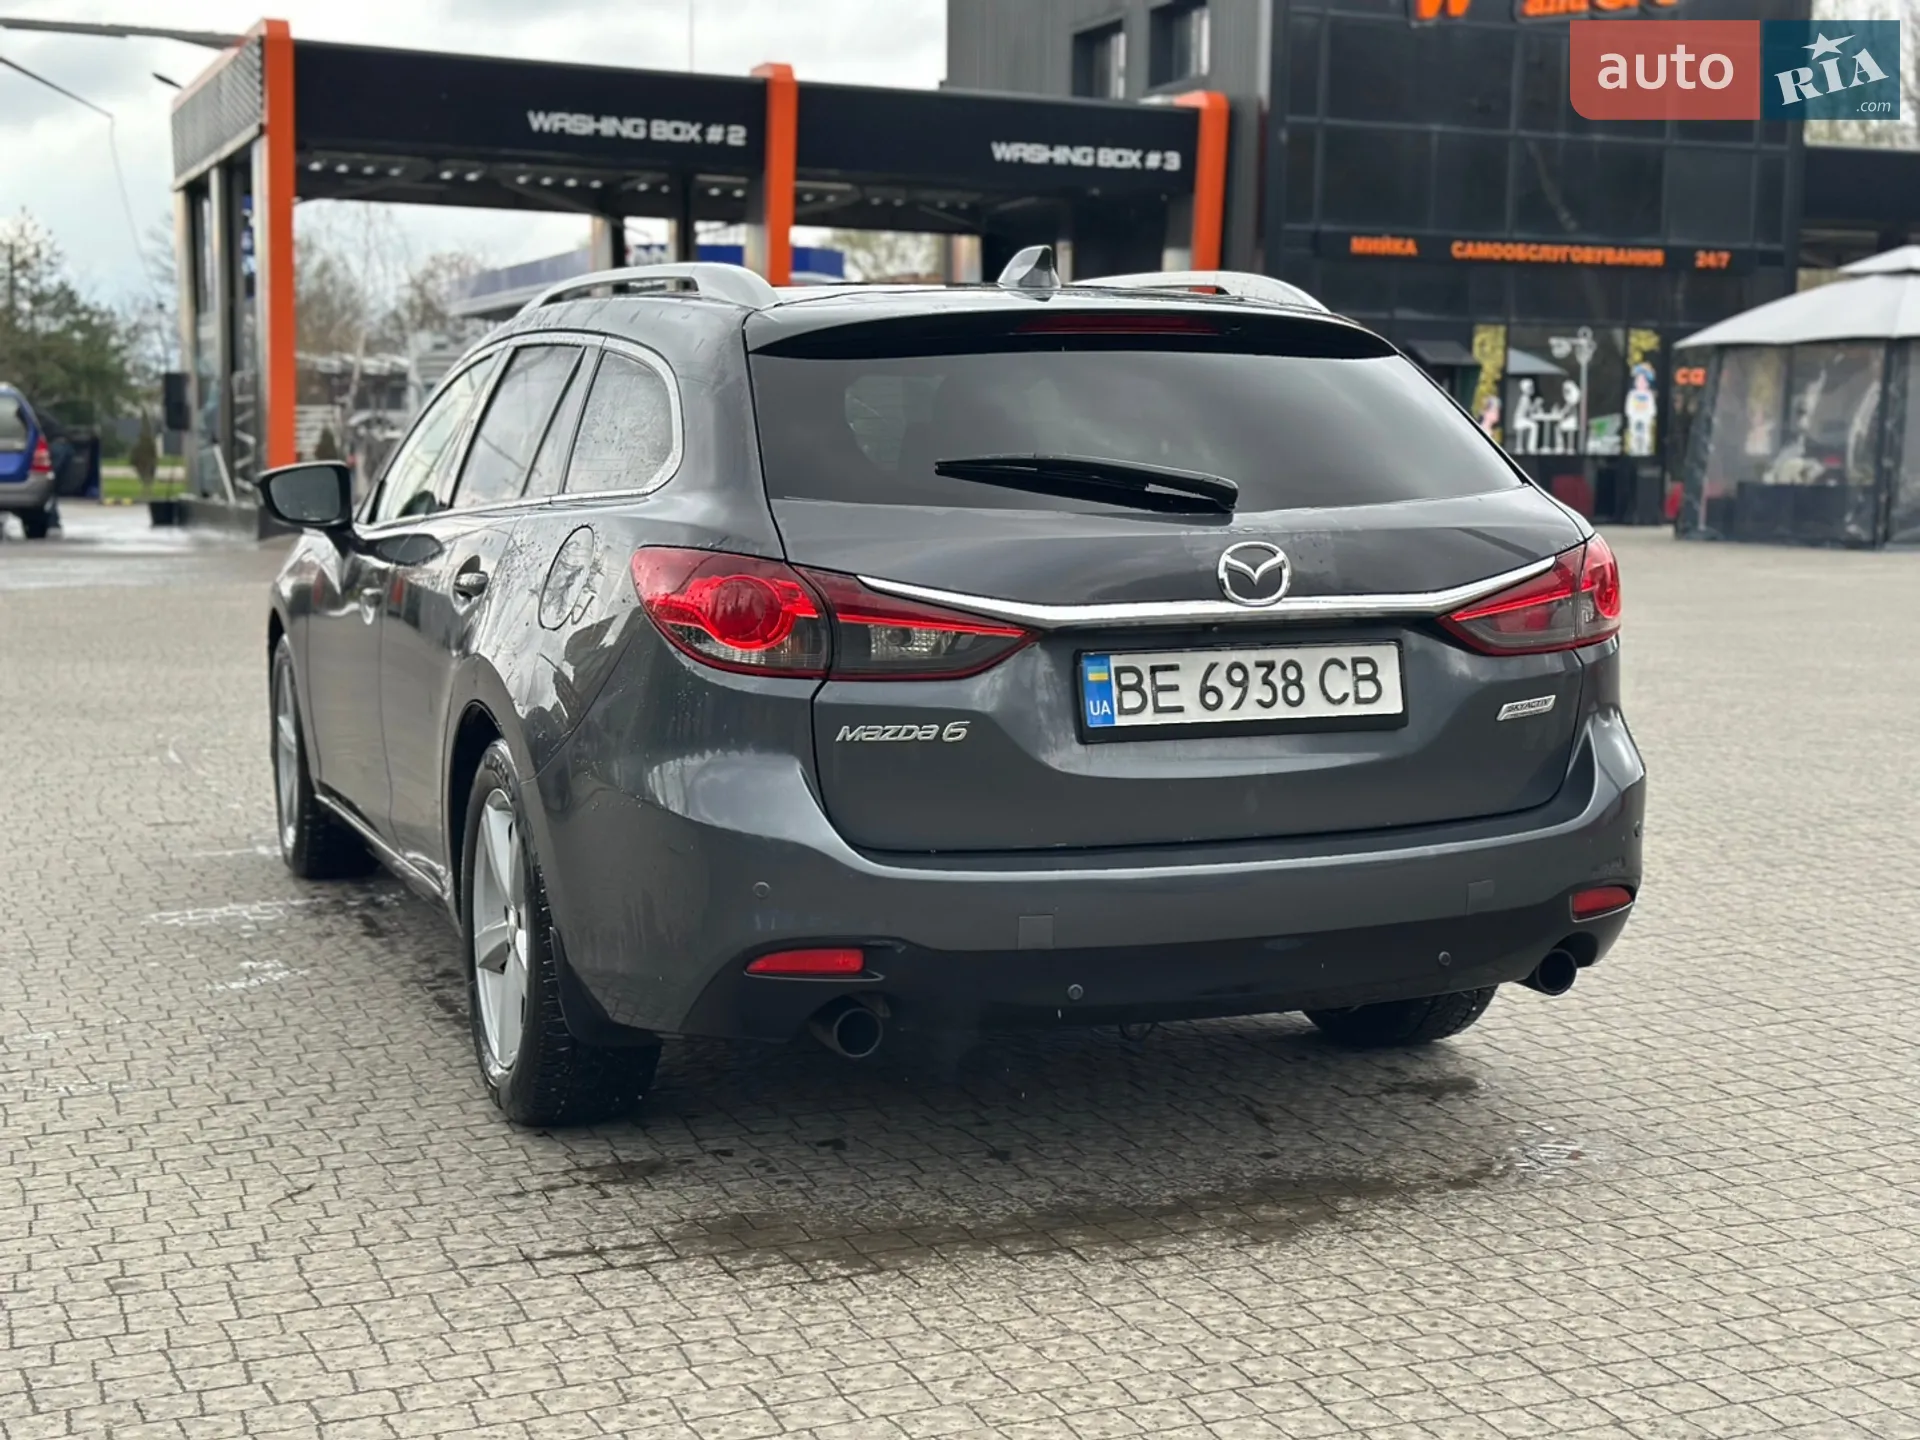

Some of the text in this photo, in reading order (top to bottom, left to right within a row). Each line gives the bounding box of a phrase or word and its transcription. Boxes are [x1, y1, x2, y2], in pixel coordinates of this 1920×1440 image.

[527, 110, 647, 140] WASHING
[650, 119, 702, 143] BOX
[990, 141, 1095, 166] WASHING
[1097, 147, 1143, 169] BOX
[1114, 656, 1382, 716] BE 6938 CB
[1090, 700, 1111, 716] UA
